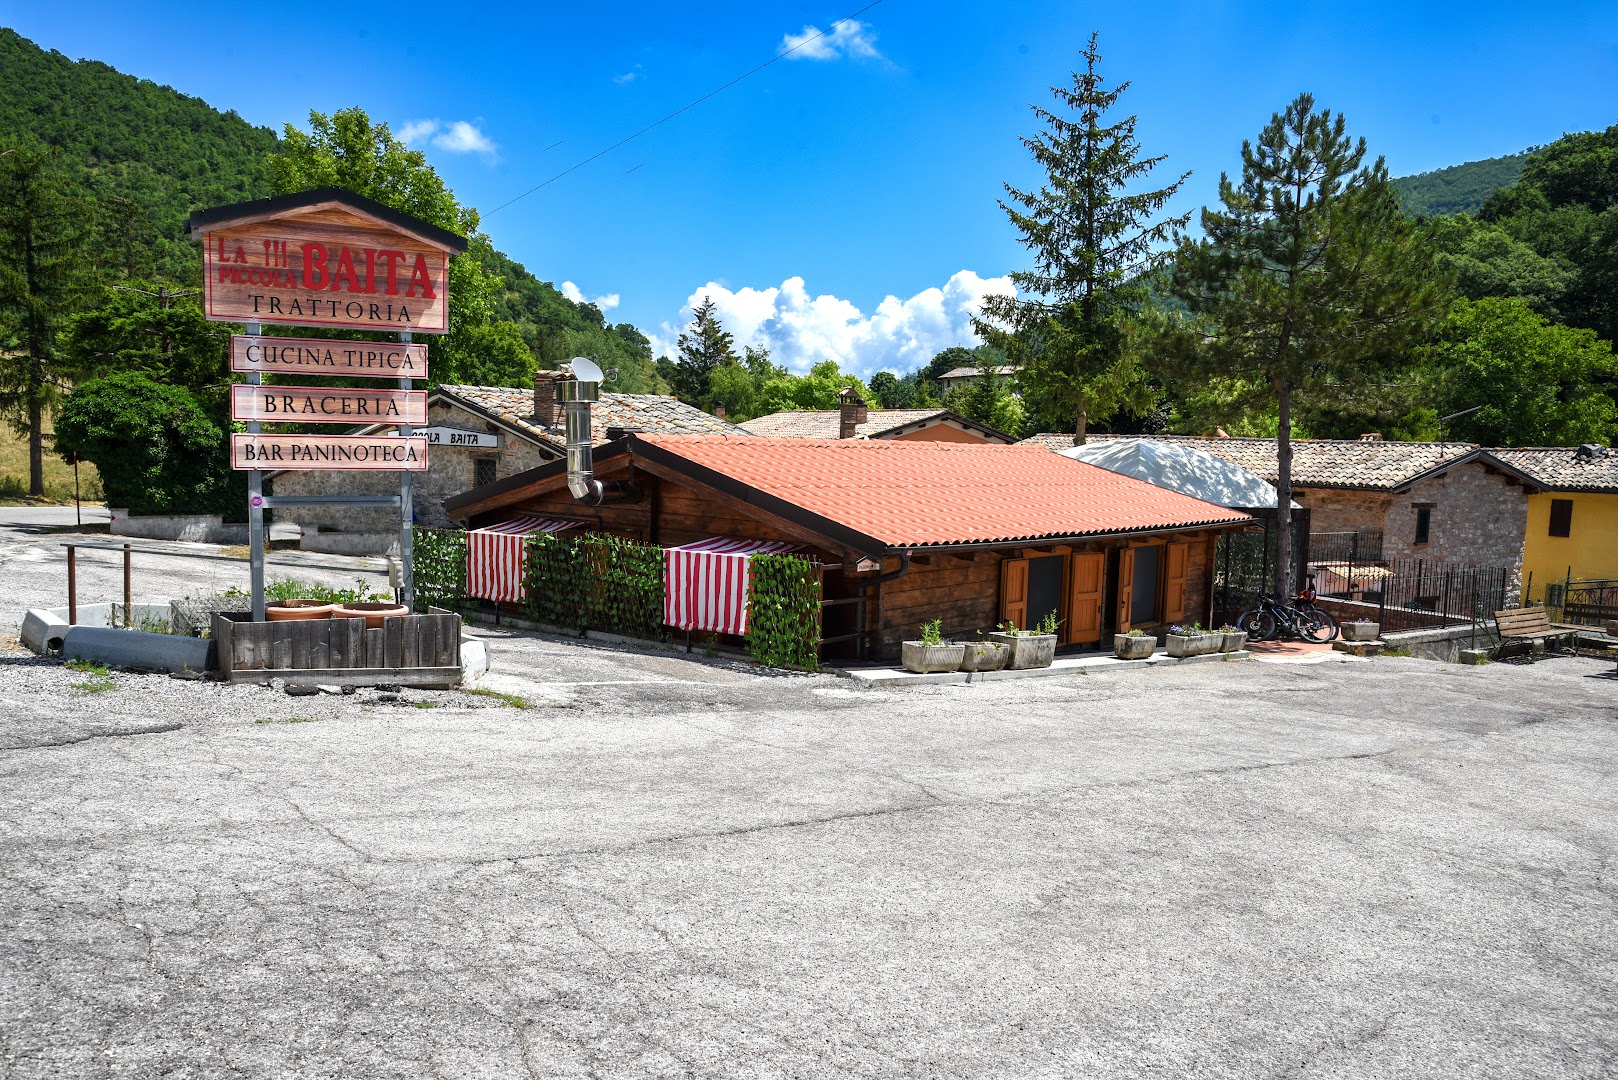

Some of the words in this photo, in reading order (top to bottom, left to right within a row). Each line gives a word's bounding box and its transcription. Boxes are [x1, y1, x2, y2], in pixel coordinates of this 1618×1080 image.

[218, 238, 248, 264] LA
[218, 266, 297, 289] PICCOLA
[301, 243, 437, 299] BAITA
[248, 294, 411, 322] TRATTORIA
[246, 345, 335, 366] CUCINA
[343, 350, 414, 369] TIPICA
[264, 394, 400, 416] BRACERIA
[450, 433, 478, 445] BAITA
[244, 444, 284, 461] BAR
[291, 444, 418, 462] PANINOTECA
